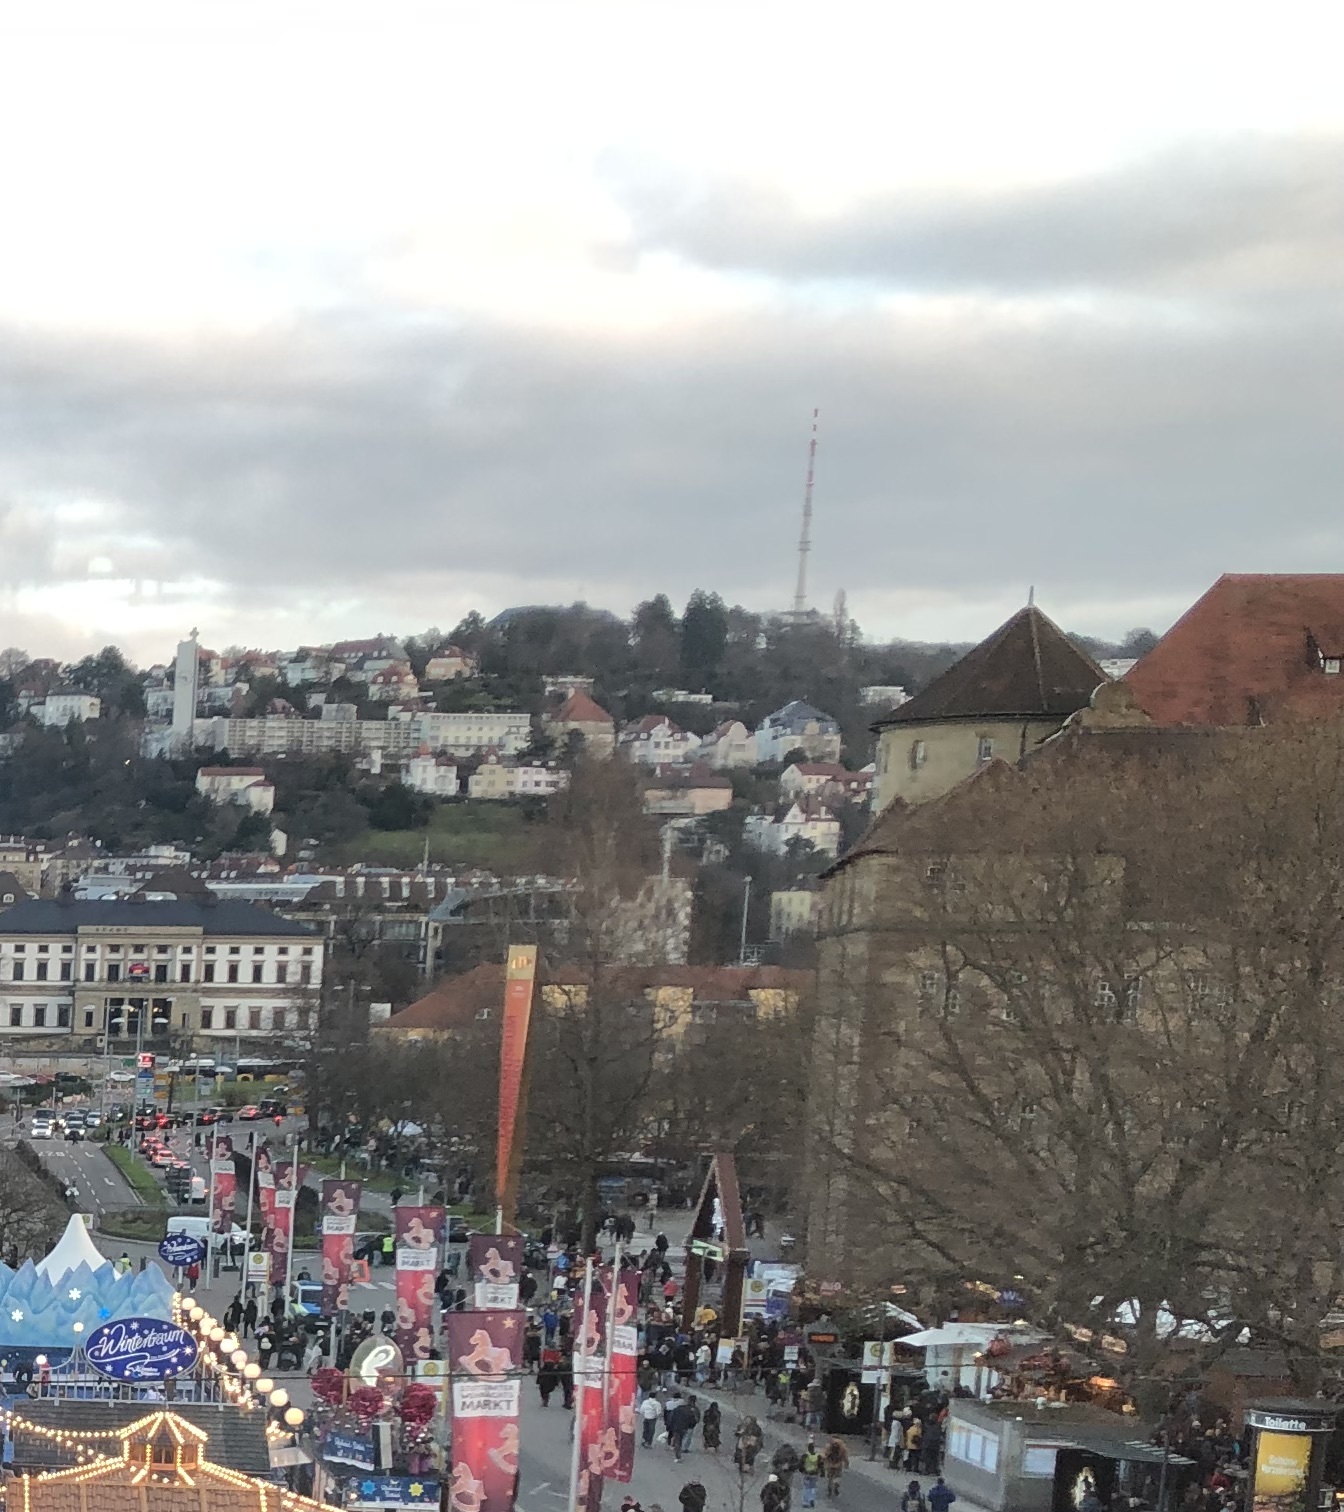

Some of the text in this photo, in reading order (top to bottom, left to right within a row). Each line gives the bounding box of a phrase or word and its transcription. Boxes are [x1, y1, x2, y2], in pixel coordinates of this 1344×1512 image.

[98, 1323, 185, 1358] Wintertraum
[460, 1399, 514, 1411] MARKT
[1264, 1416, 1307, 1431] Toilette
